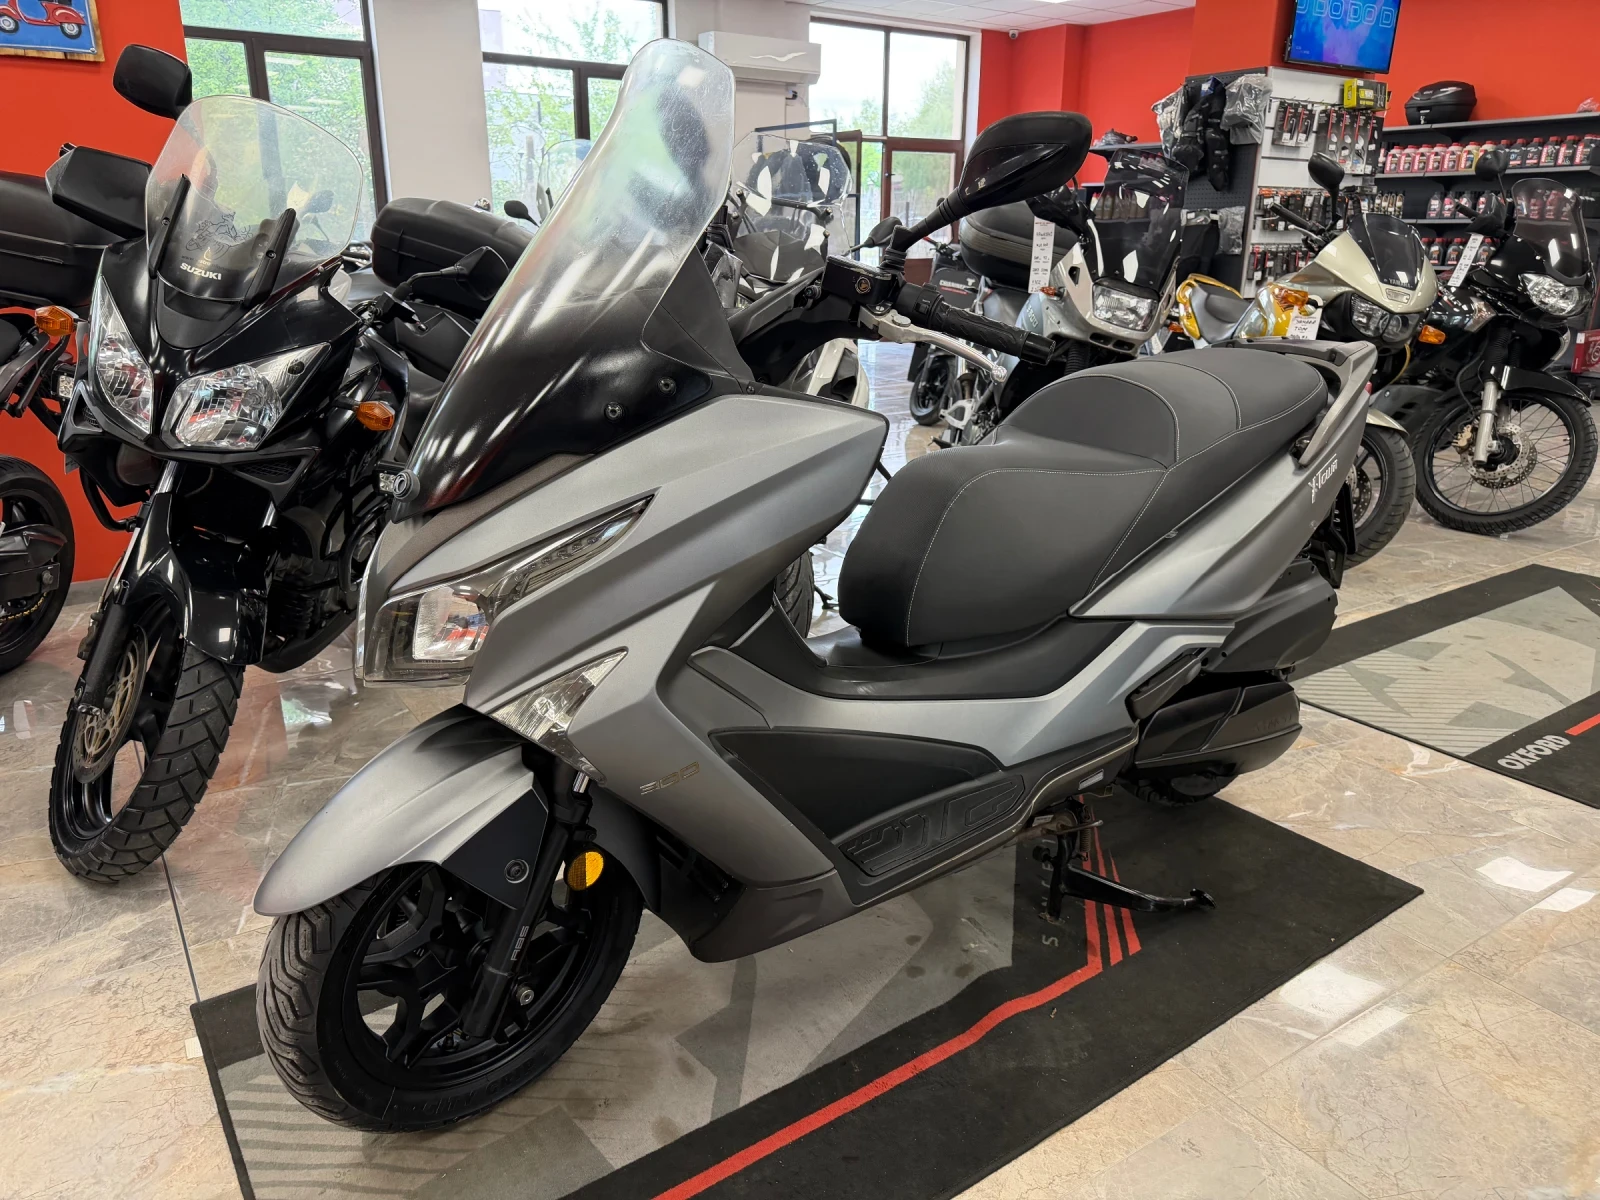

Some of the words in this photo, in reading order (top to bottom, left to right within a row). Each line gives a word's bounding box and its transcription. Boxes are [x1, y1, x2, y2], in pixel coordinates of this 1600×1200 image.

[180, 262, 222, 280] SUZUKI
[1497, 735, 1571, 770] OXFORD
[640, 761, 700, 796] 300
[510, 925, 530, 961] ABS
